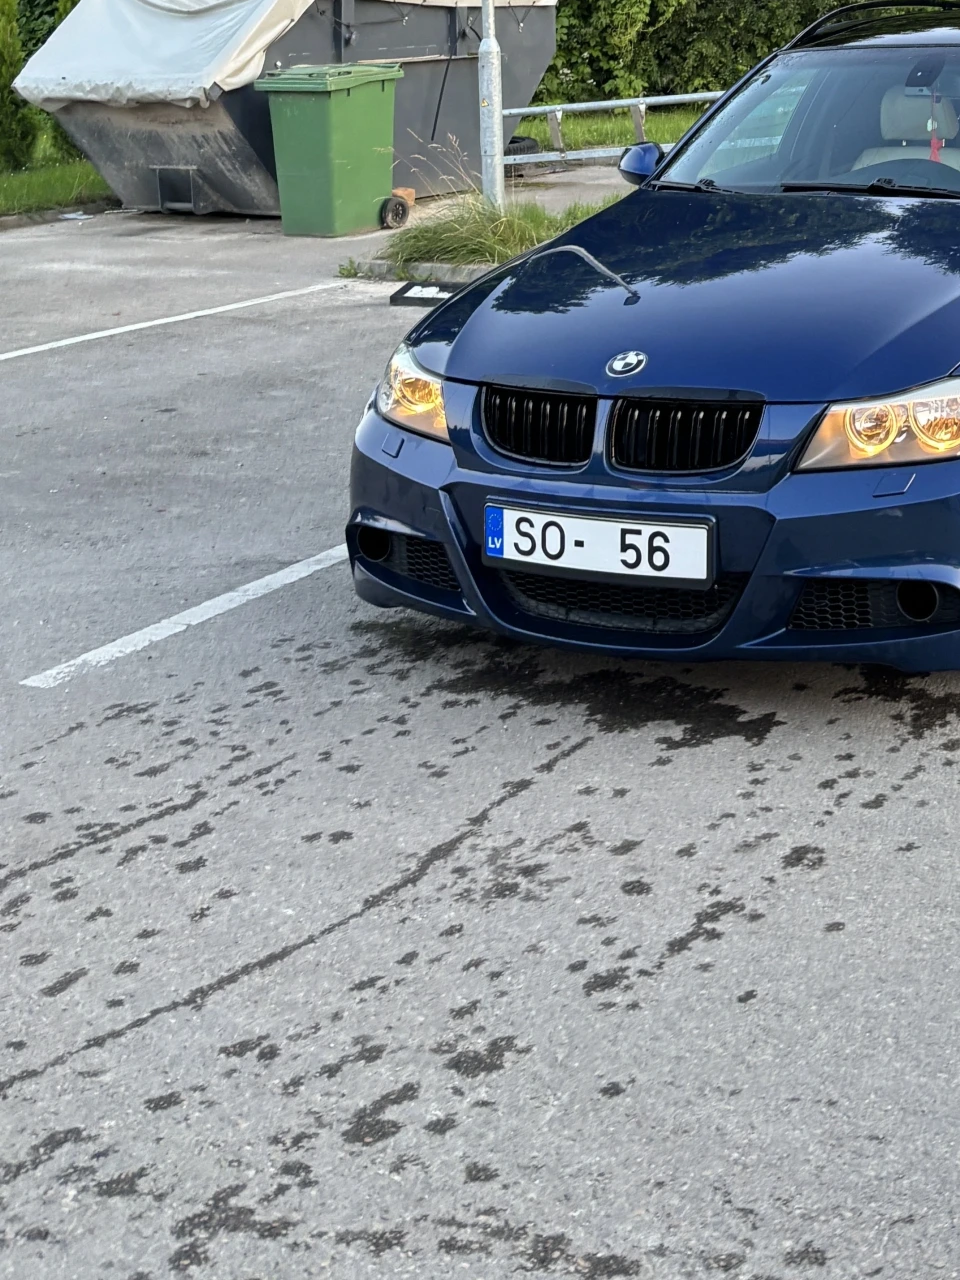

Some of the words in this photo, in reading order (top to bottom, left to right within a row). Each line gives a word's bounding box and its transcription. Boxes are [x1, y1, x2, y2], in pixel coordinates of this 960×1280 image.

[488, 535, 502, 549] LV
[513, 516, 585, 561] SO-
[620, 527, 670, 572] 56
